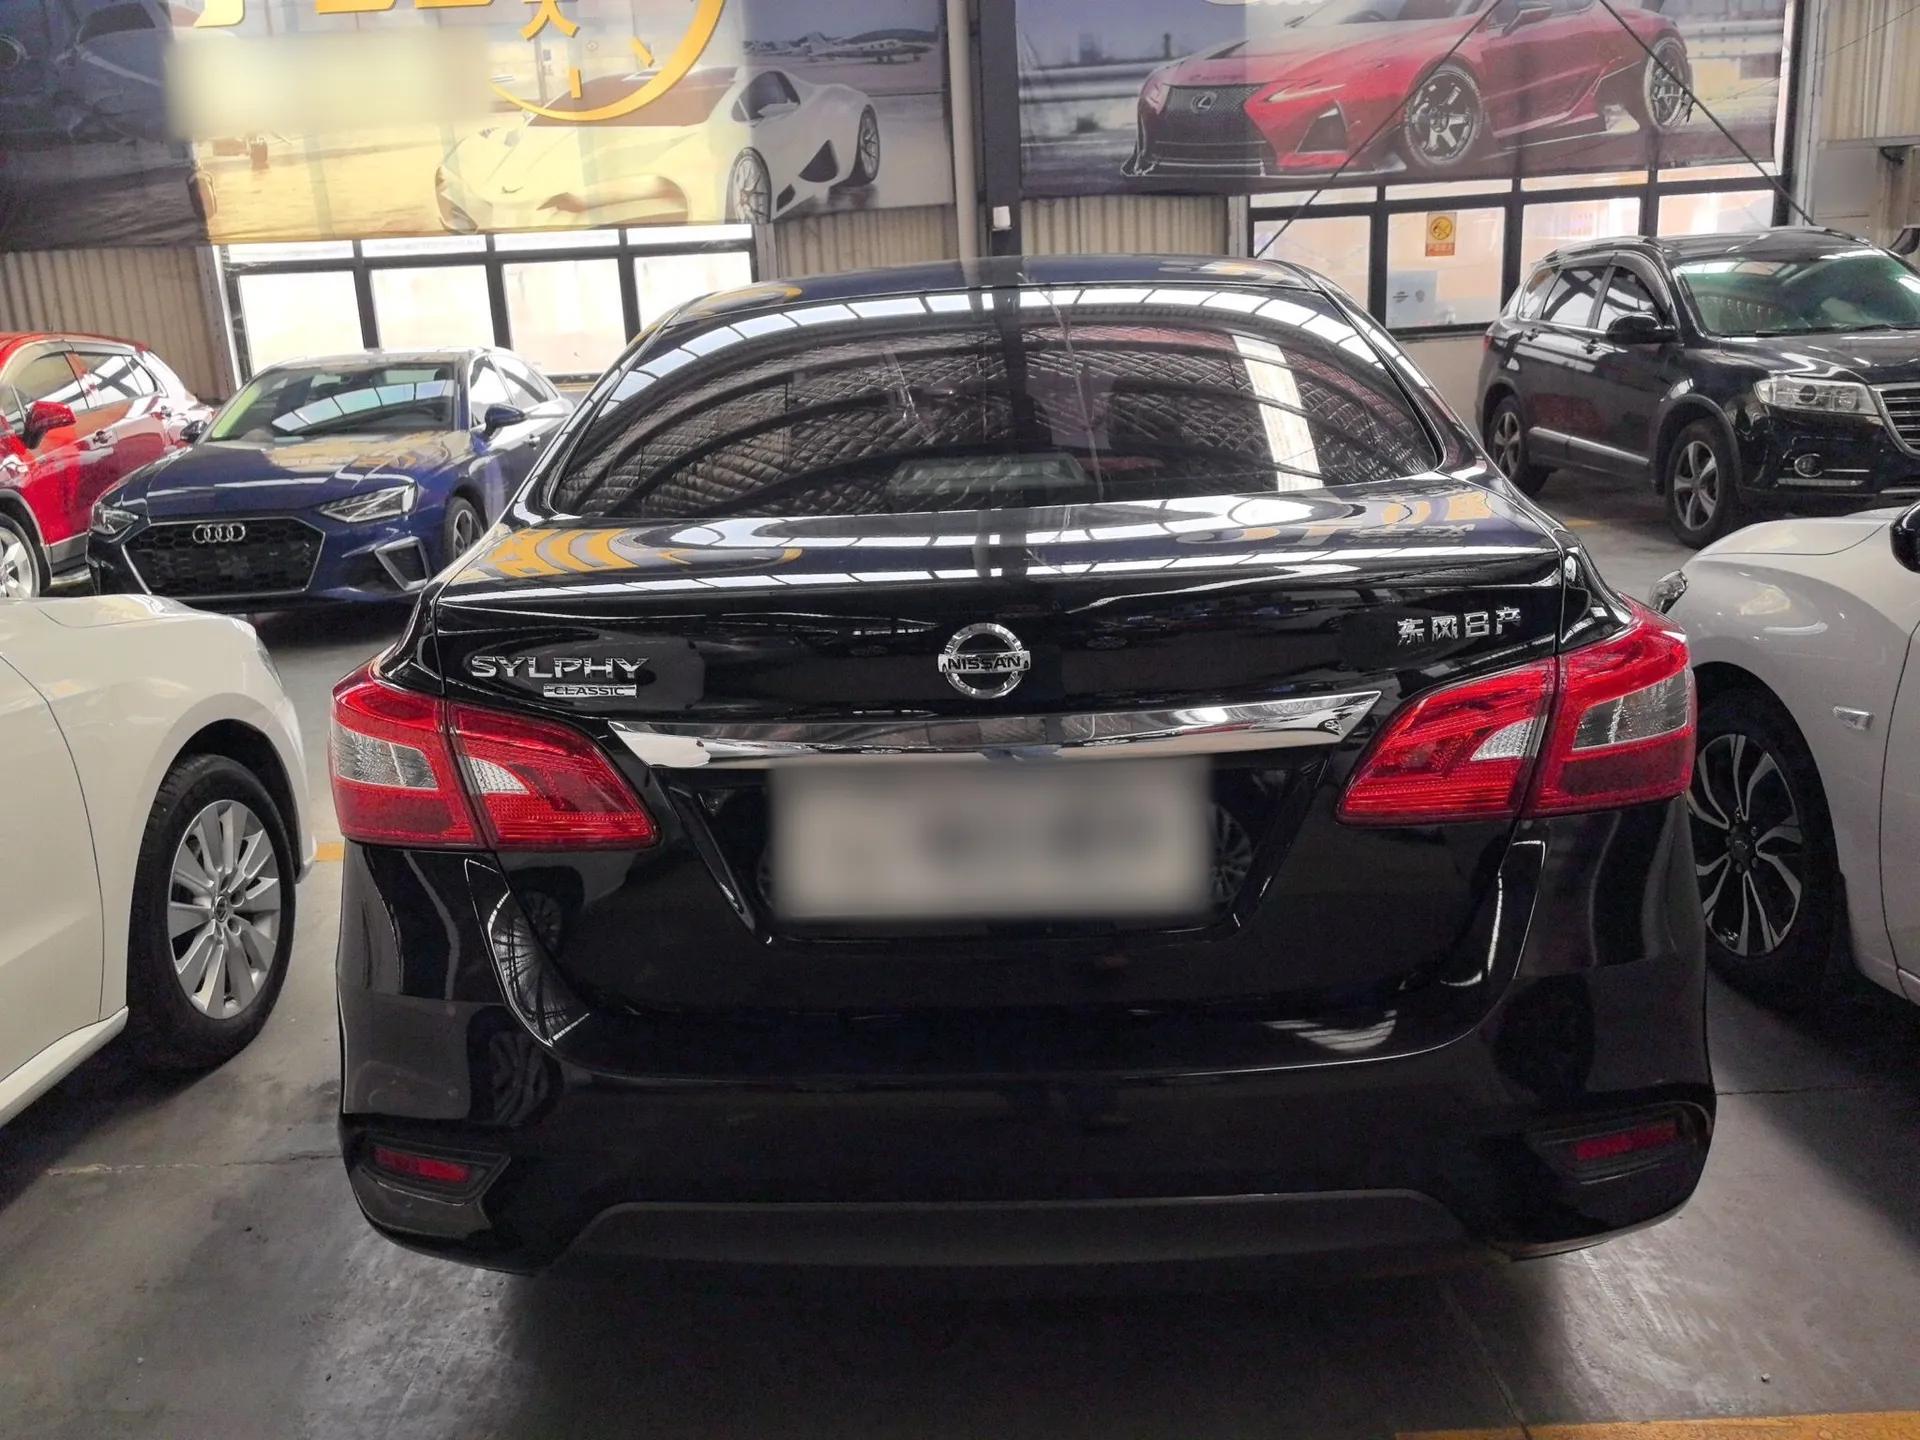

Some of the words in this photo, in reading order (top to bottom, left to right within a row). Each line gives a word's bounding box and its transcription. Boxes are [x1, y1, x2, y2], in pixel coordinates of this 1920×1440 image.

[1397, 606, 1521, 644] 东风日产
[471, 655, 649, 679] SYLPHY
[946, 654, 1022, 671] NISSAN
[552, 685, 627, 697] CLASSIC
